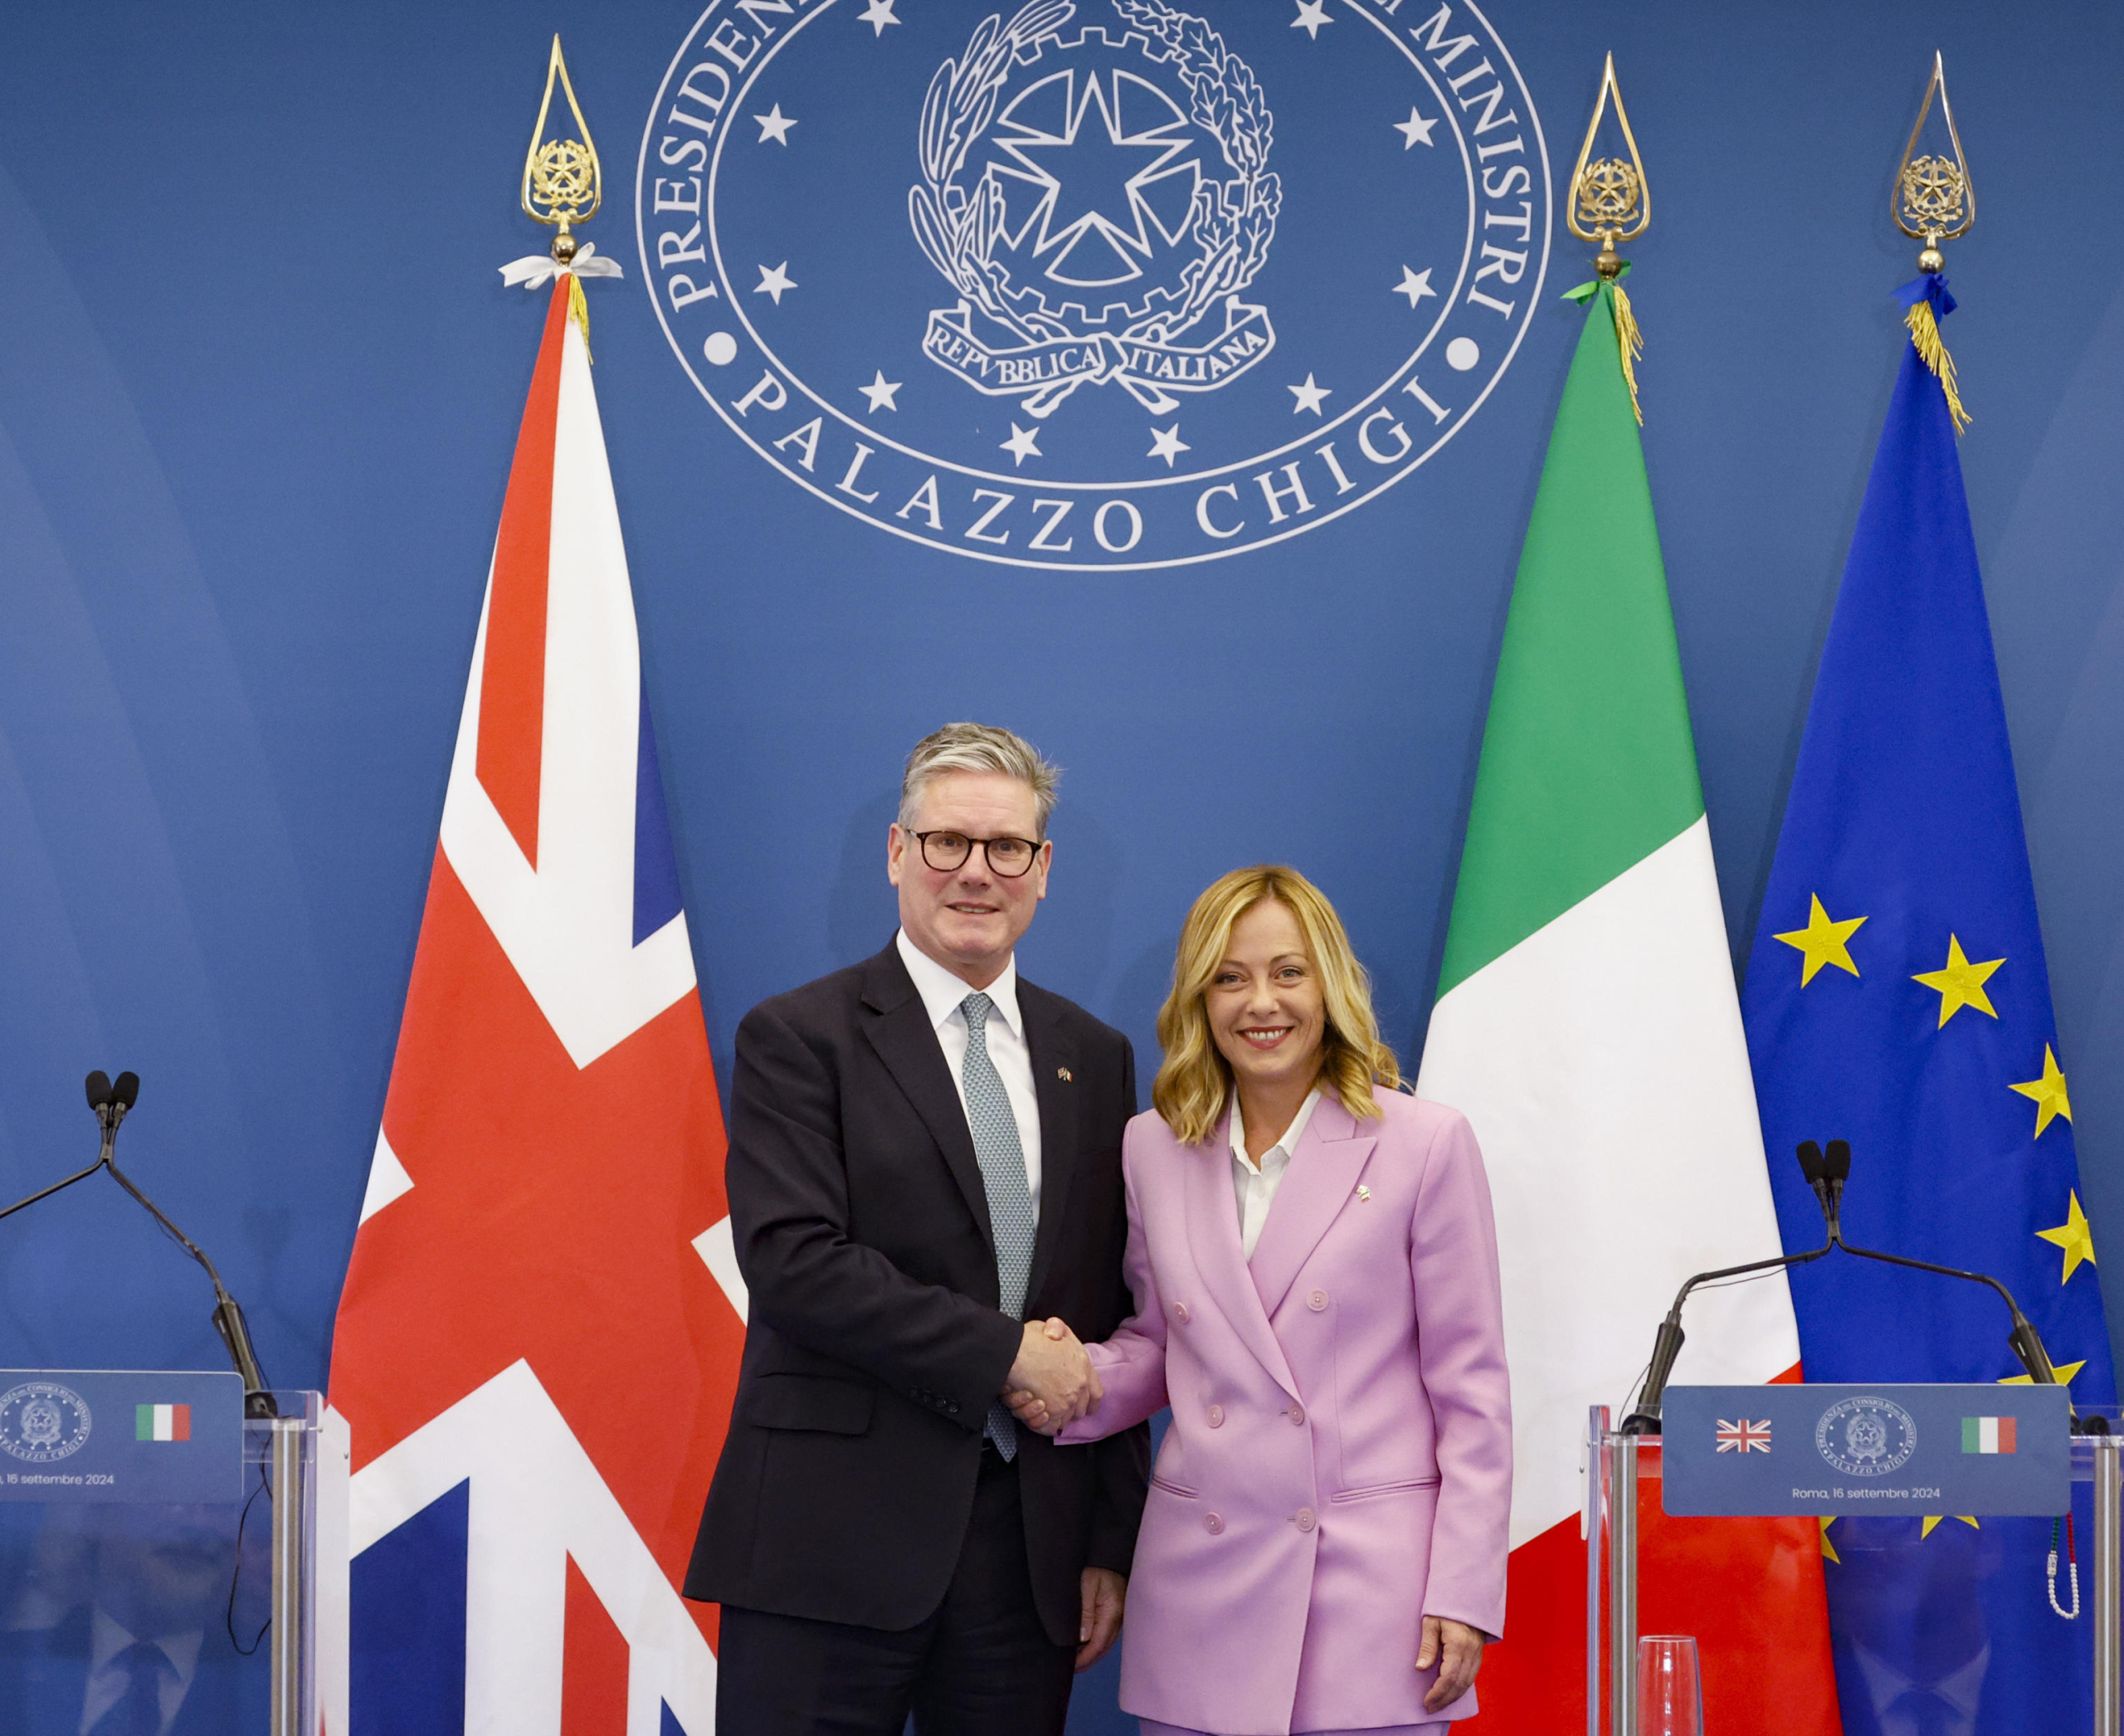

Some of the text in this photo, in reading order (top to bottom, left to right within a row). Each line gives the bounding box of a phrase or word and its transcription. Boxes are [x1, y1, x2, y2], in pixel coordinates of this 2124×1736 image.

[654, 0, 810, 314] PRESIDEN
[1409, 2, 1532, 320] MINISTRI
[927, 326, 1267, 384] REPVBBLICA ITALIANA
[731, 369, 1451, 553] PALAZZO CHIGI
[7, 1473, 18, 1485] 16
[21, 1474, 82, 1485] settembre
[85, 1474, 114, 1485] 2024
[1792, 1488, 1941, 1499] Roma, 16 settembre 2024
[1826, 1454, 1873, 1475] PALAZZO
